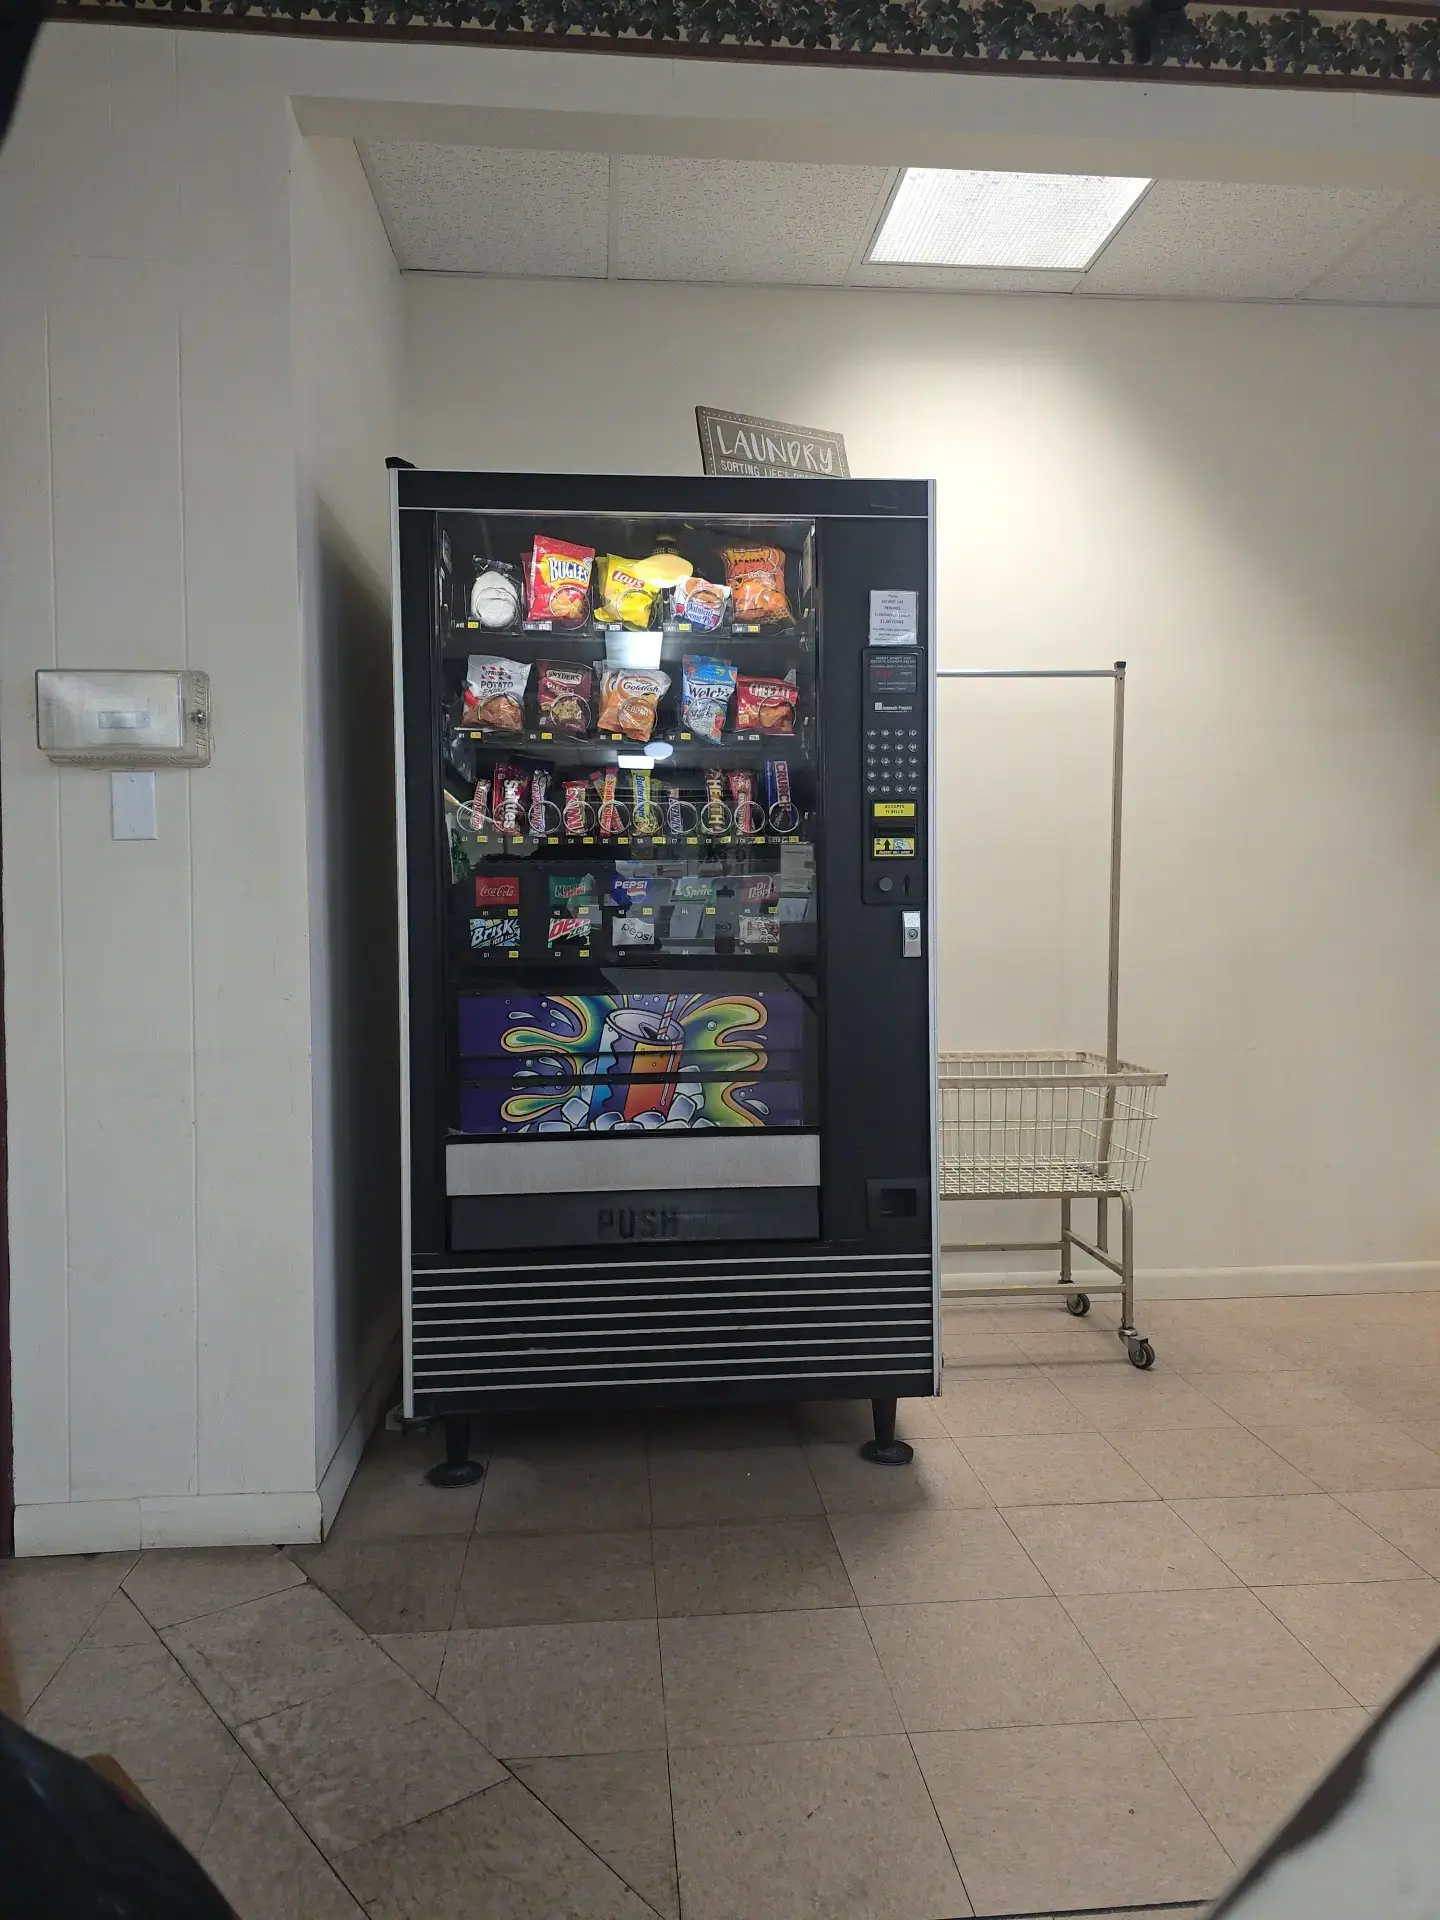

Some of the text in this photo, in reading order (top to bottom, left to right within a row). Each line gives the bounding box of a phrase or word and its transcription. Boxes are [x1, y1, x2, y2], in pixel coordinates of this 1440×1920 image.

[717, 425, 833, 473] LAUNDRY
[720, 459, 760, 476] SORTING
[548, 556, 588, 583] BUGLES
[549, 671, 580, 681] SNYDER'S
[481, 680, 513, 688] POTATO
[623, 681, 659, 693] Goldfish
[688, 683, 730, 698] Welch's
[707, 780, 723, 824] HEATH
[614, 880, 648, 889] PEPSI
[683, 885, 713, 898] Sprite
[748, 886, 771, 900] Pepp
[621, 923, 653, 942] pepsi
[598, 1203, 678, 1239] PUSH
